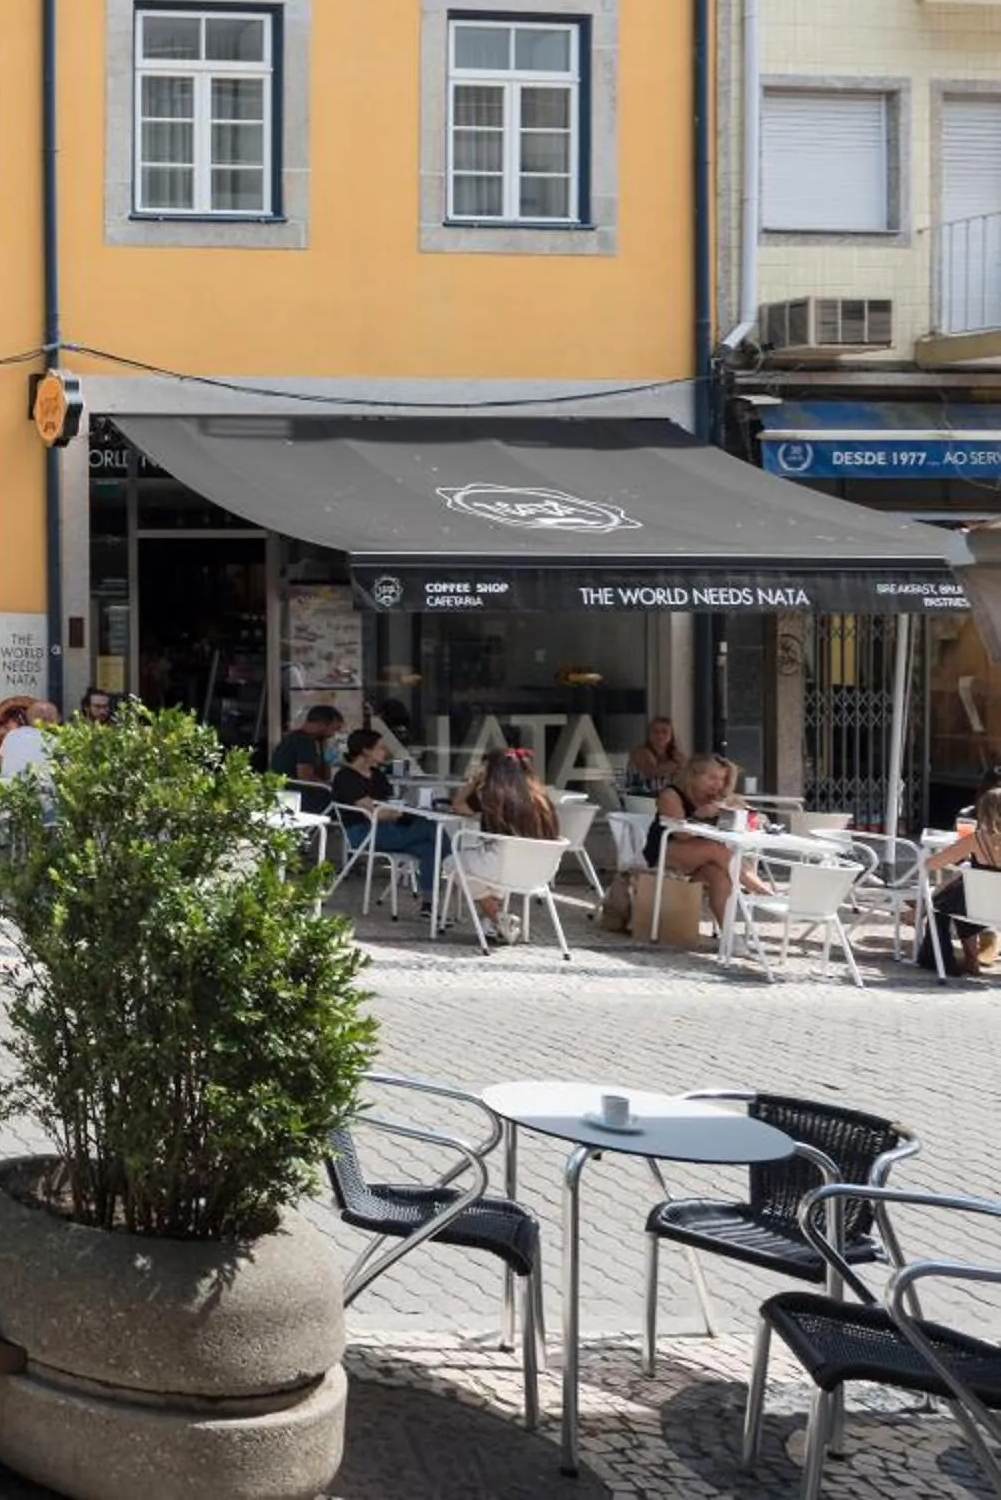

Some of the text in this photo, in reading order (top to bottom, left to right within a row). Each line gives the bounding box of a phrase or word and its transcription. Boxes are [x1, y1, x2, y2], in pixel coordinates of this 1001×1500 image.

[88, 449, 129, 468] ORL
[832, 452, 886, 465] DESDE
[943, 451, 967, 465] AO
[425, 582, 509, 593] COFFEE SHOP
[579, 587, 811, 606] THE WORLD NEEDS NATA
[11, 632, 35, 645] THE
[1, 646, 44, 659] WORLD
[2, 660, 42, 673] NEEDS
[6, 673, 38, 686] NATA
